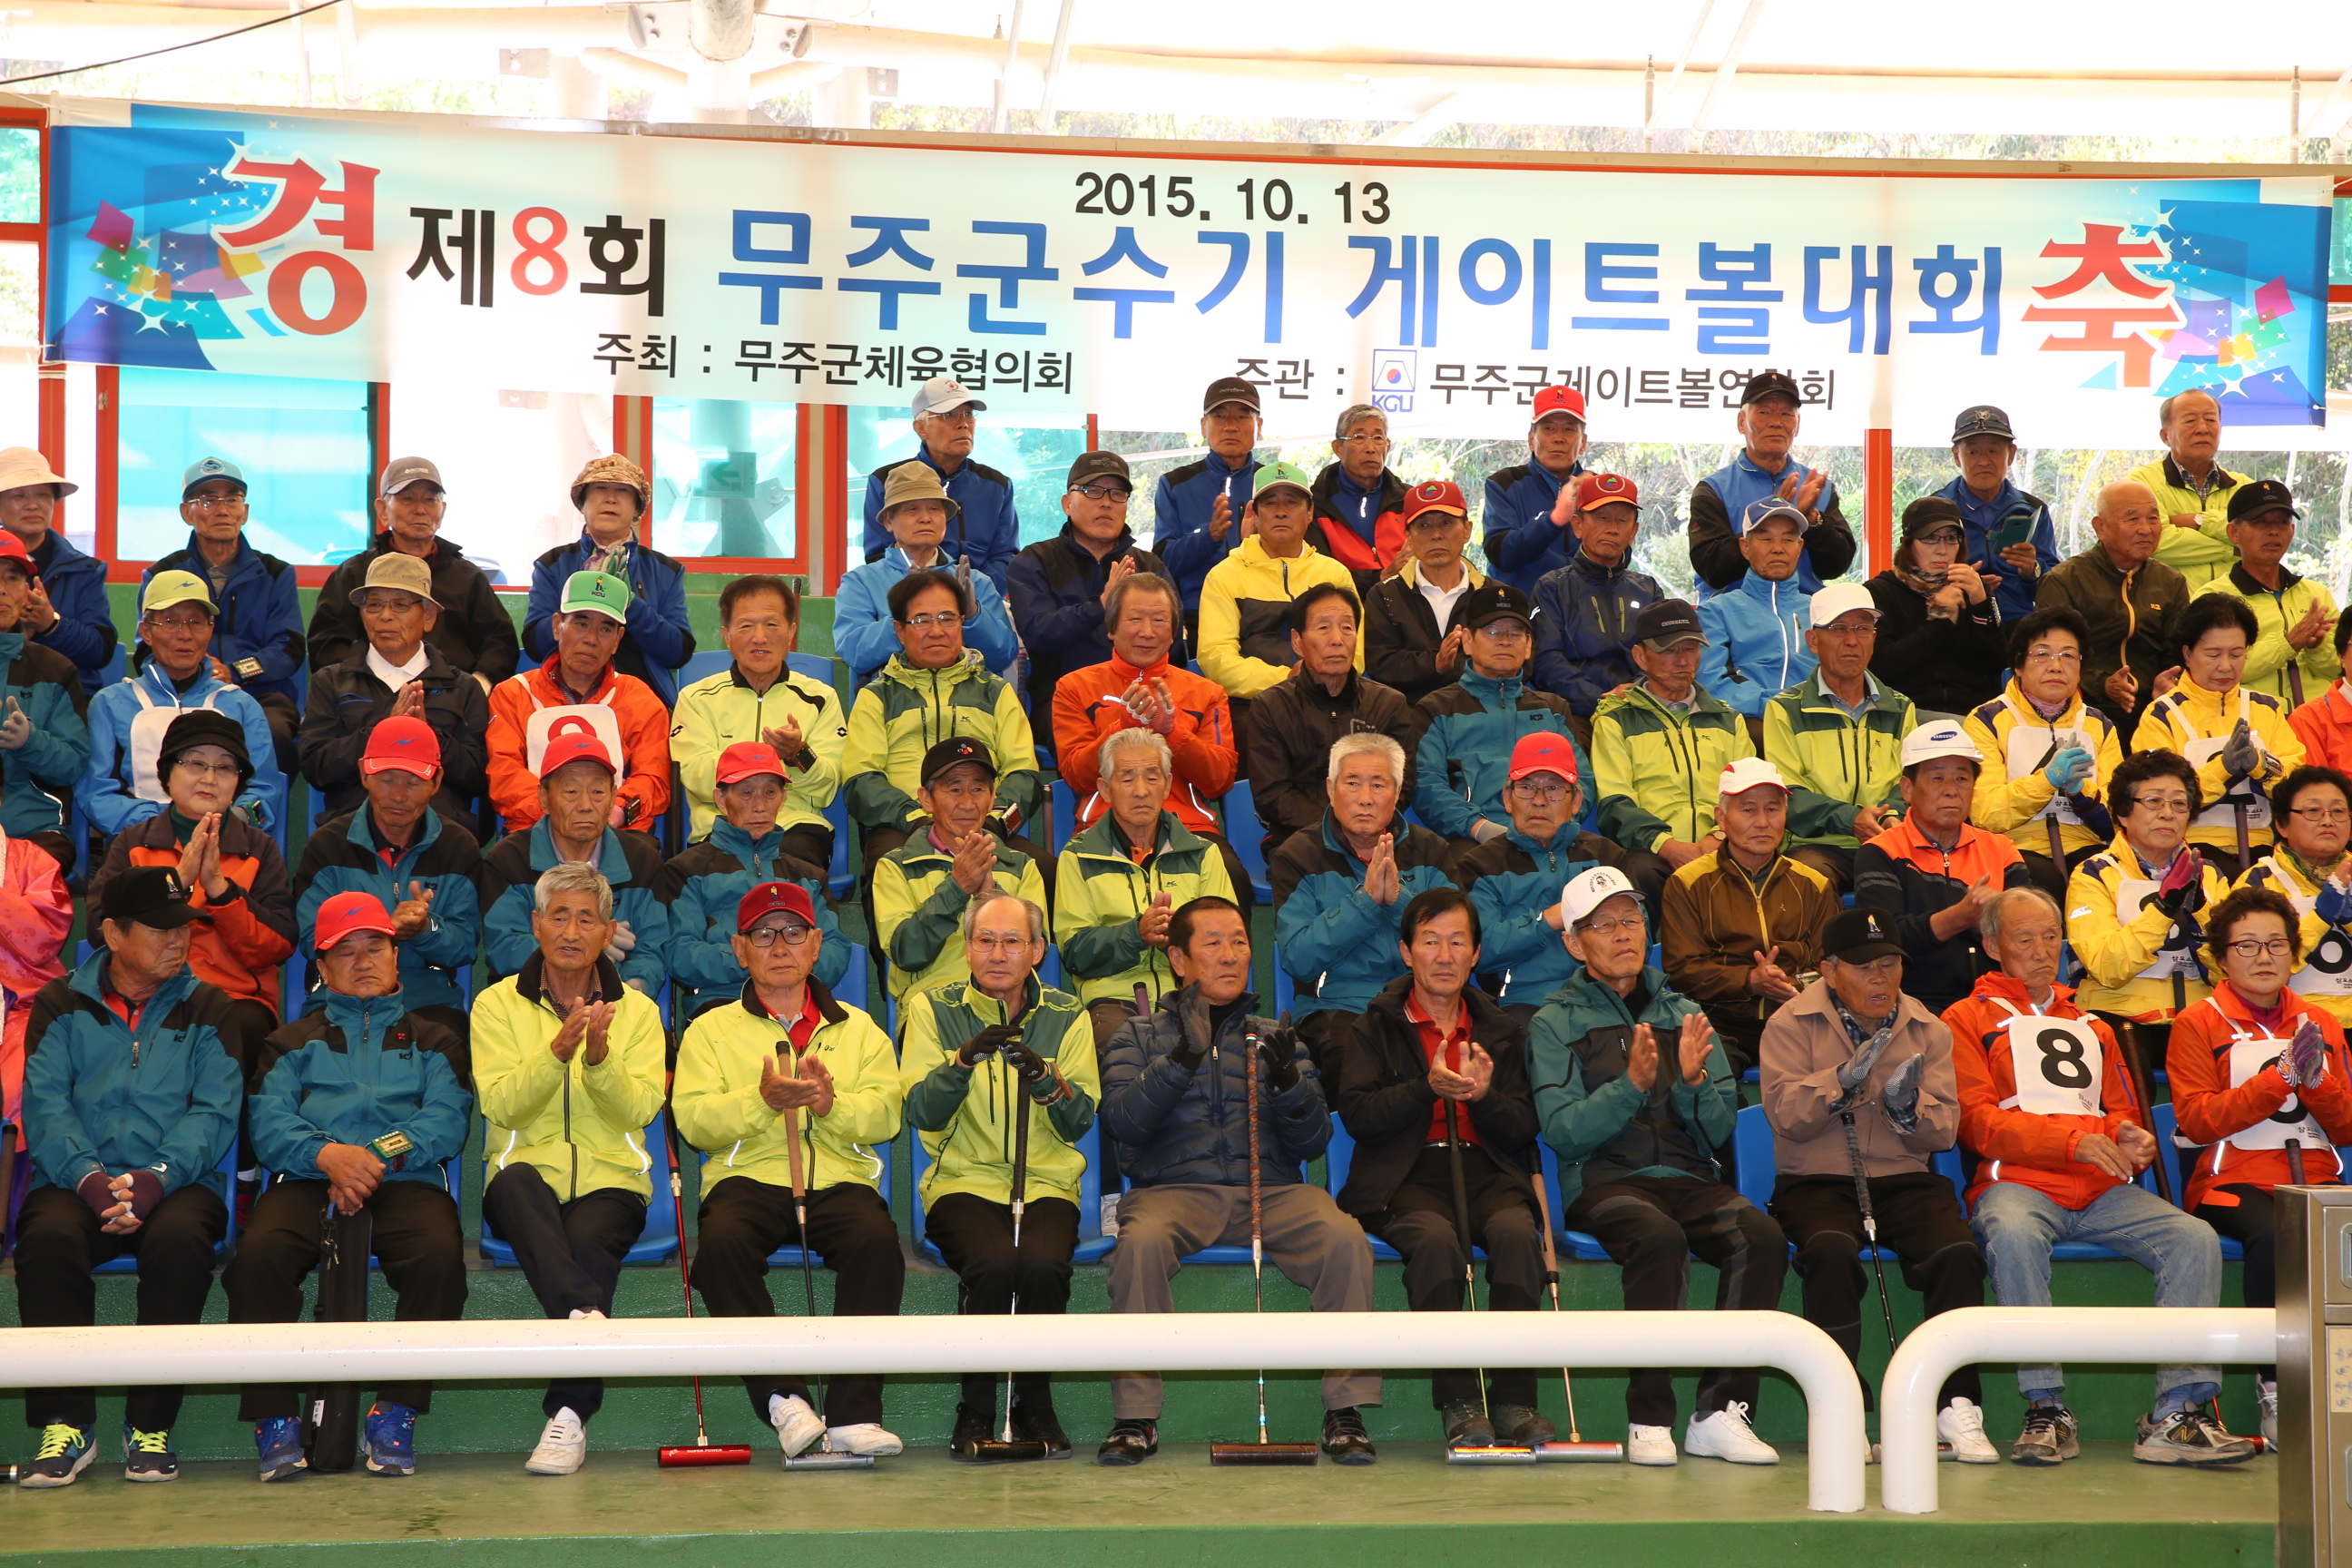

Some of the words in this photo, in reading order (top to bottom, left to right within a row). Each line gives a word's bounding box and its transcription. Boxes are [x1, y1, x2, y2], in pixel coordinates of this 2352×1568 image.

[1075, 172, 1210, 221] 2015.
[1237, 178, 1308, 224] 10.
[1334, 181, 1390, 225] 13
[220, 159, 380, 336] 경
[406, 206, 666, 318] 제8회
[719, 210, 1284, 344] 무주군수기
[1345, 236, 2002, 356] 게이트볼대회
[2023, 223, 2178, 388] 축
[593, 333, 677, 378] 주최
[734, 339, 1073, 396] 무주군체육협의회
[1235, 358, 1315, 400] 주관
[1430, 364, 1834, 410] 무주군게이트볼연회
[1529, 713, 1544, 721] K2
[424, 881, 439, 890] K2
[1402, 874, 1416, 882] K2
[2036, 1028, 2092, 1089] 8
